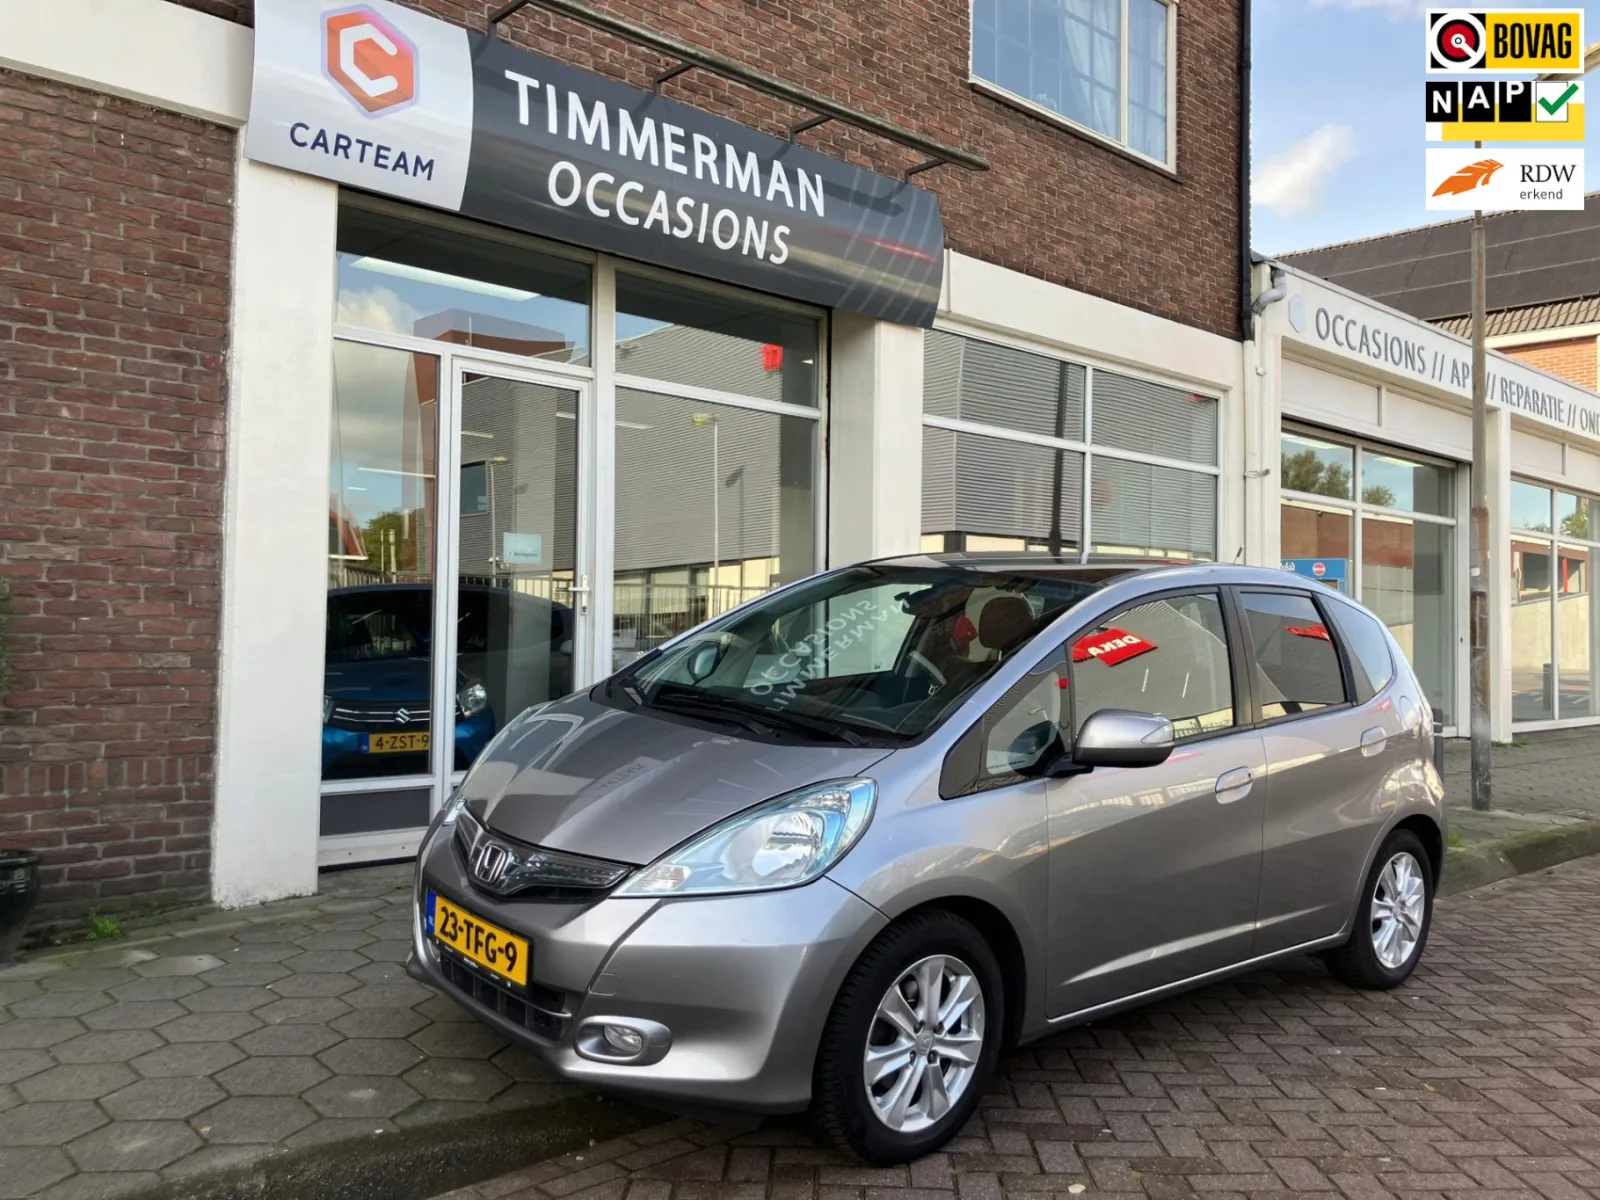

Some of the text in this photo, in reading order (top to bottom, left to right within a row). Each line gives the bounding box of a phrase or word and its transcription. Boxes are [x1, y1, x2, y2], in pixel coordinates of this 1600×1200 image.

[289, 122, 435, 182] CARTEAM
[504, 69, 825, 217] TIMMERMAN
[548, 160, 790, 265] OCCASIONS
[1315, 307, 1426, 374] OCCASIONS
[1450, 358, 1473, 389] AP
[1500, 376, 1565, 423] REPARATIE
[375, 734, 429, 750] 4-ZST-9
[439, 906, 518, 973] 23-TFG-9
